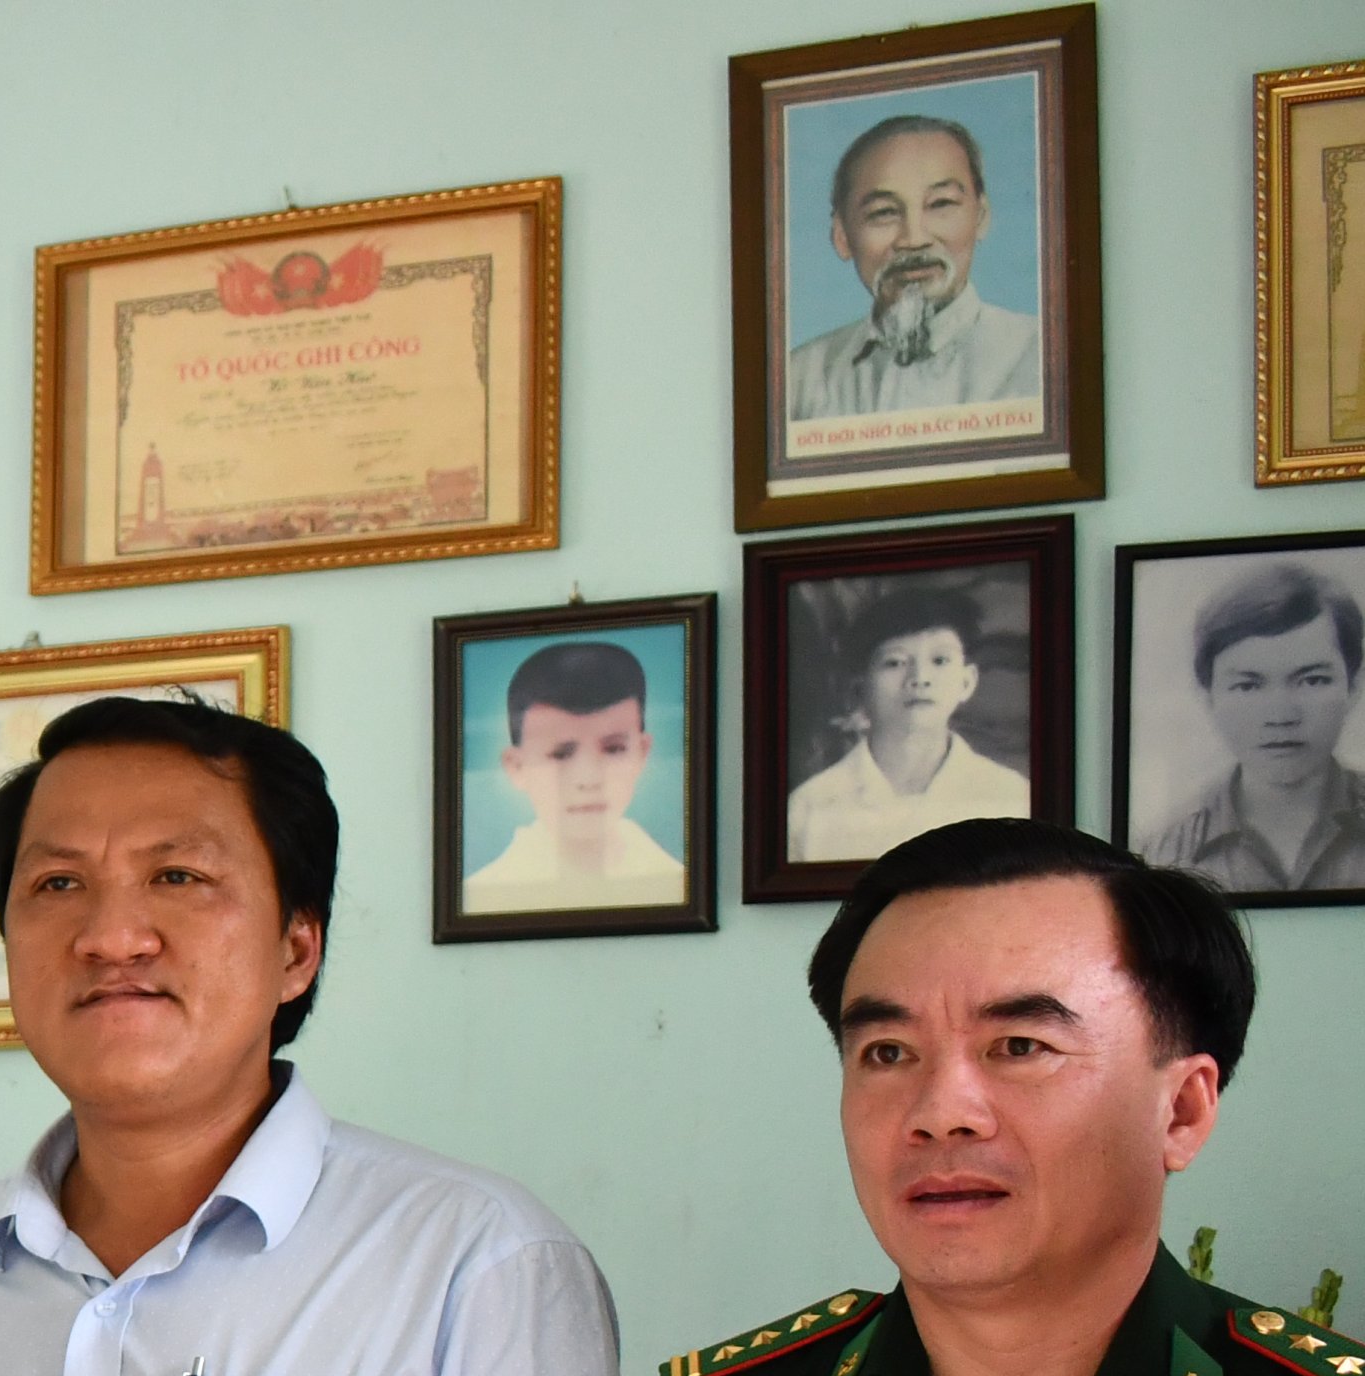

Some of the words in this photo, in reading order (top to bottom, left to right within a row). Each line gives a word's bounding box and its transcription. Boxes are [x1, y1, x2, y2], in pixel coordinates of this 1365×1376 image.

[176, 355, 209, 383] TỔ
[217, 349, 289, 381] QUỐC
[297, 345, 340, 367] GHI
[348, 336, 422, 362] CÔNG
[922, 419, 951, 435] BÁC
[958, 415, 979, 430] HỒ
